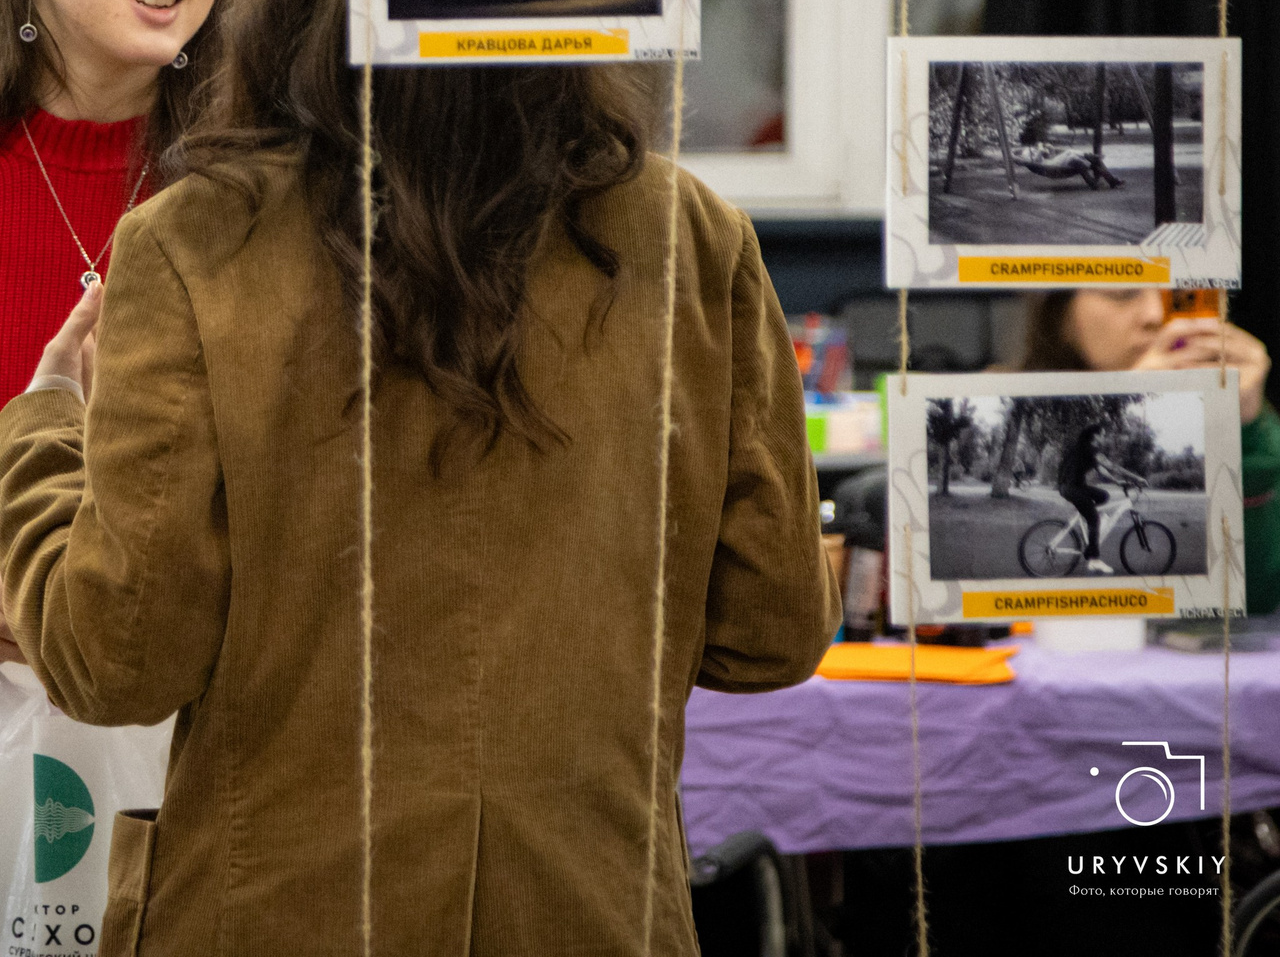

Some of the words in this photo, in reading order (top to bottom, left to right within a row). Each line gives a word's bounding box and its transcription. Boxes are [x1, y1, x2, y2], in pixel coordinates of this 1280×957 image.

[456, 38, 537, 53] КРАВЦОВА
[541, 37, 592, 52] ДАРЬЯ
[990, 262, 1144, 276] CRAMPFISHPACHUCO
[994, 595, 1148, 611] CRAMPFISHPACHUCO
